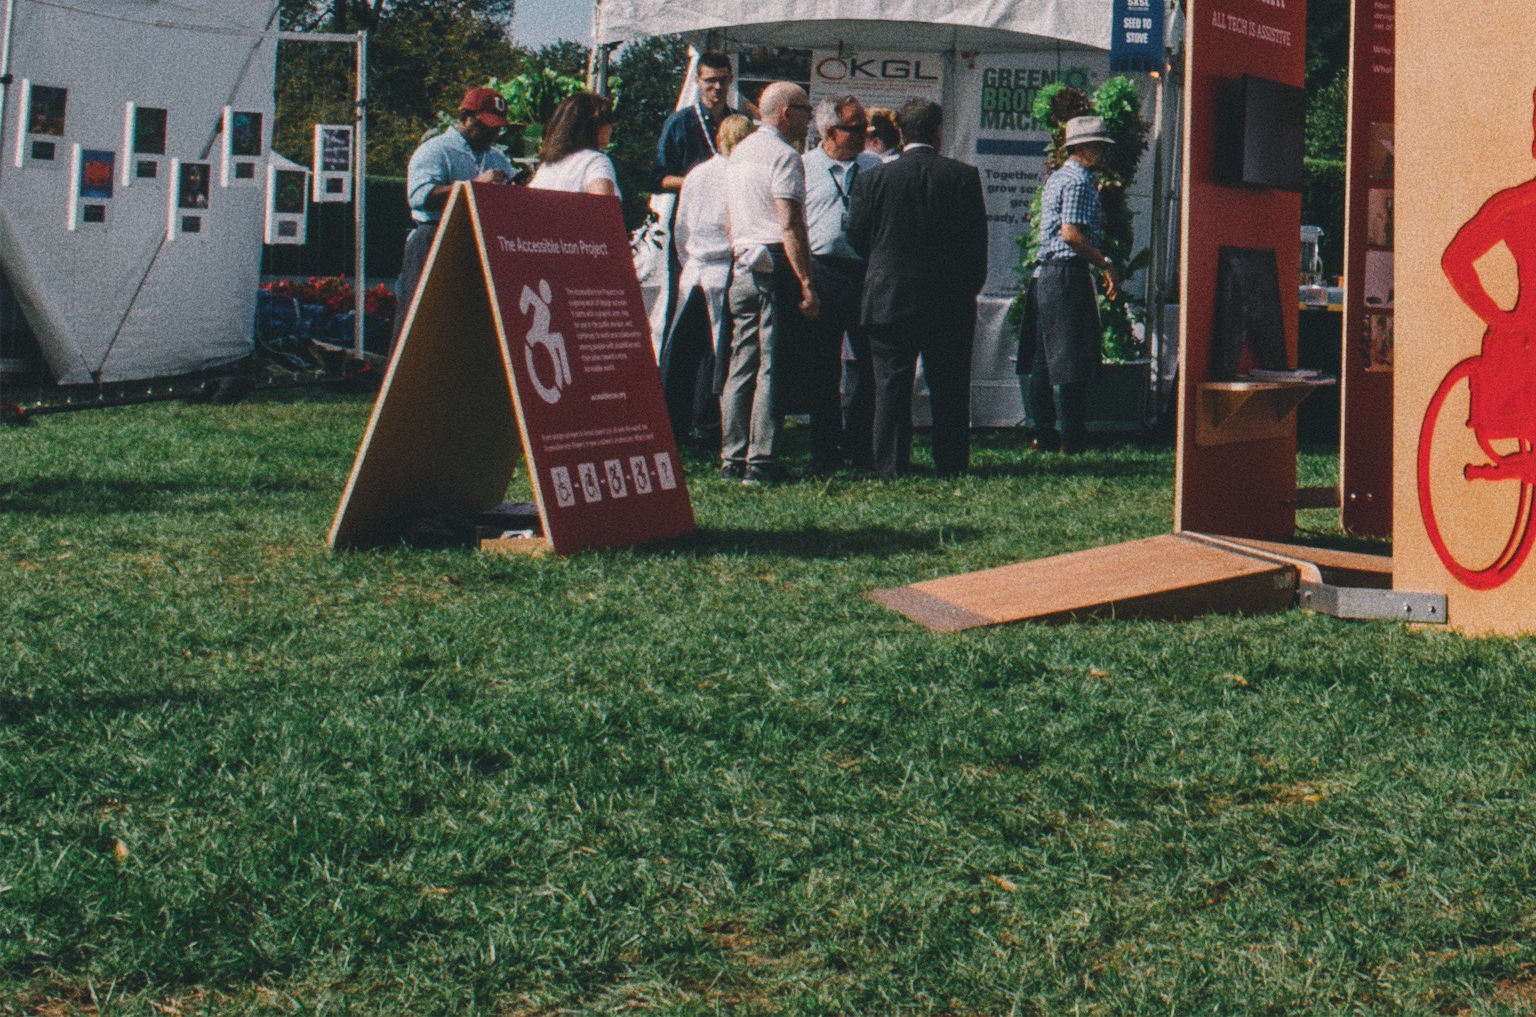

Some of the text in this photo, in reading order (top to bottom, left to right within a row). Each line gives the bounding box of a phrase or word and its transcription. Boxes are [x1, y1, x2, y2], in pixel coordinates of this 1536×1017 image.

[1211, 10, 1291, 47] ALL TECH IS ASSISTIVE
[983, 68, 1058, 86] GREEN
[987, 184, 1017, 194] grow
[497, 235, 609, 258] The Accessible Icon Project
